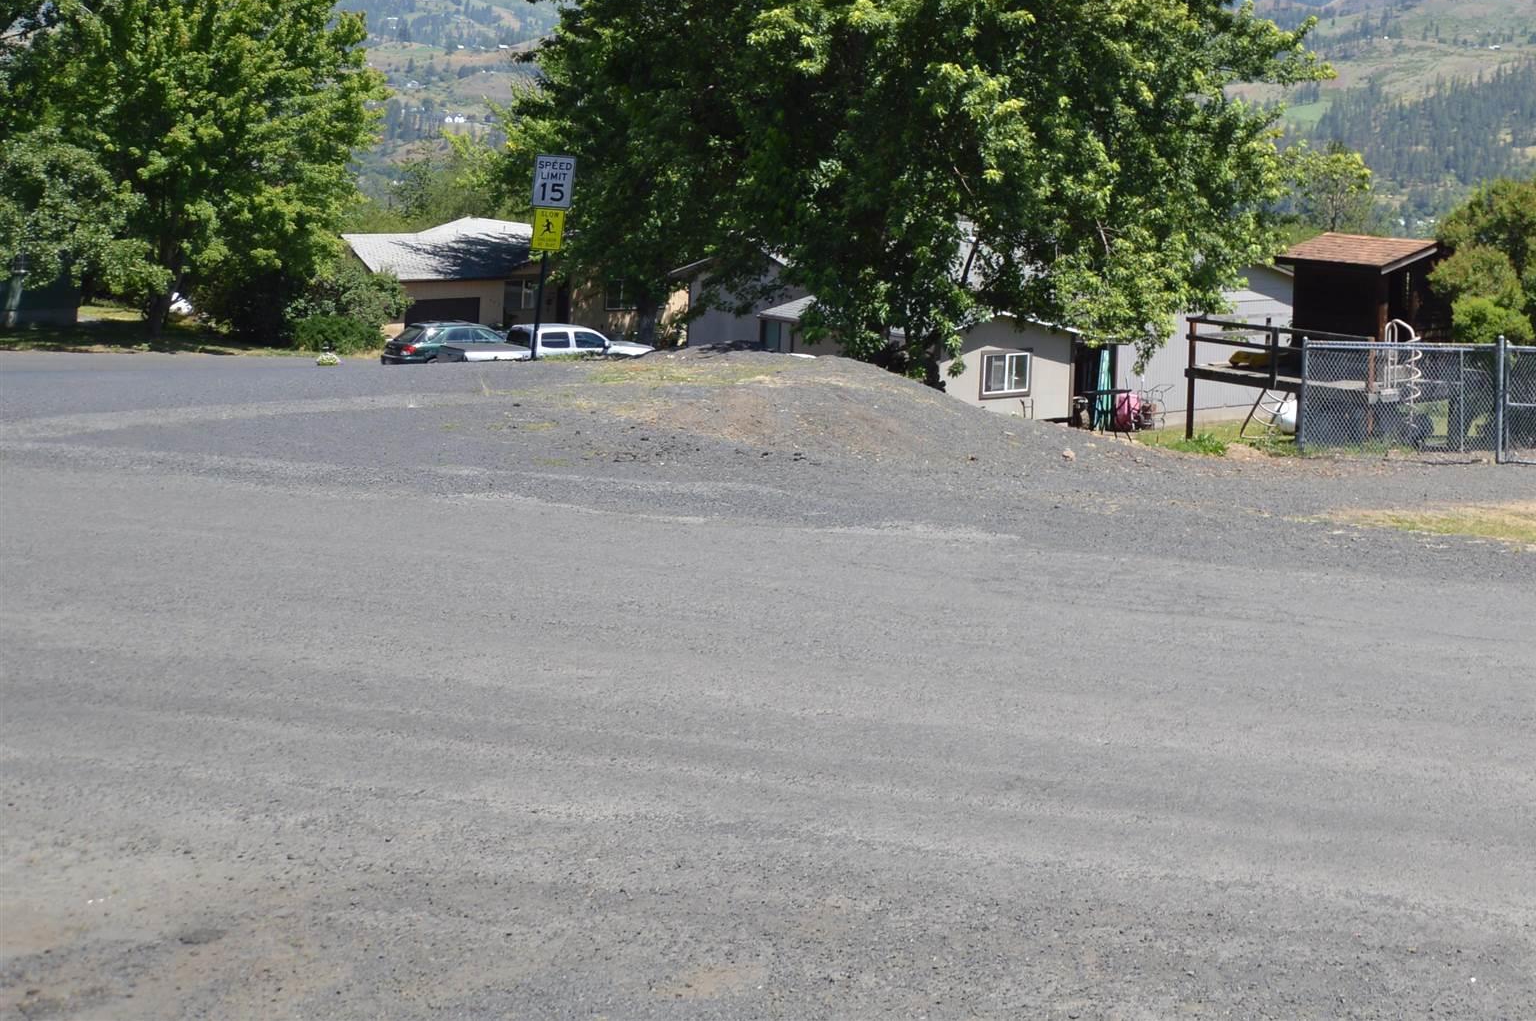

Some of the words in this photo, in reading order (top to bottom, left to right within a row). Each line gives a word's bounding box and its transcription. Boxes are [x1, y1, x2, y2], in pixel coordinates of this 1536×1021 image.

[538, 160, 573, 171] SPEED
[541, 172, 568, 181] LIMIT
[540, 182, 565, 202] 15
[541, 210, 560, 218] SLOW
